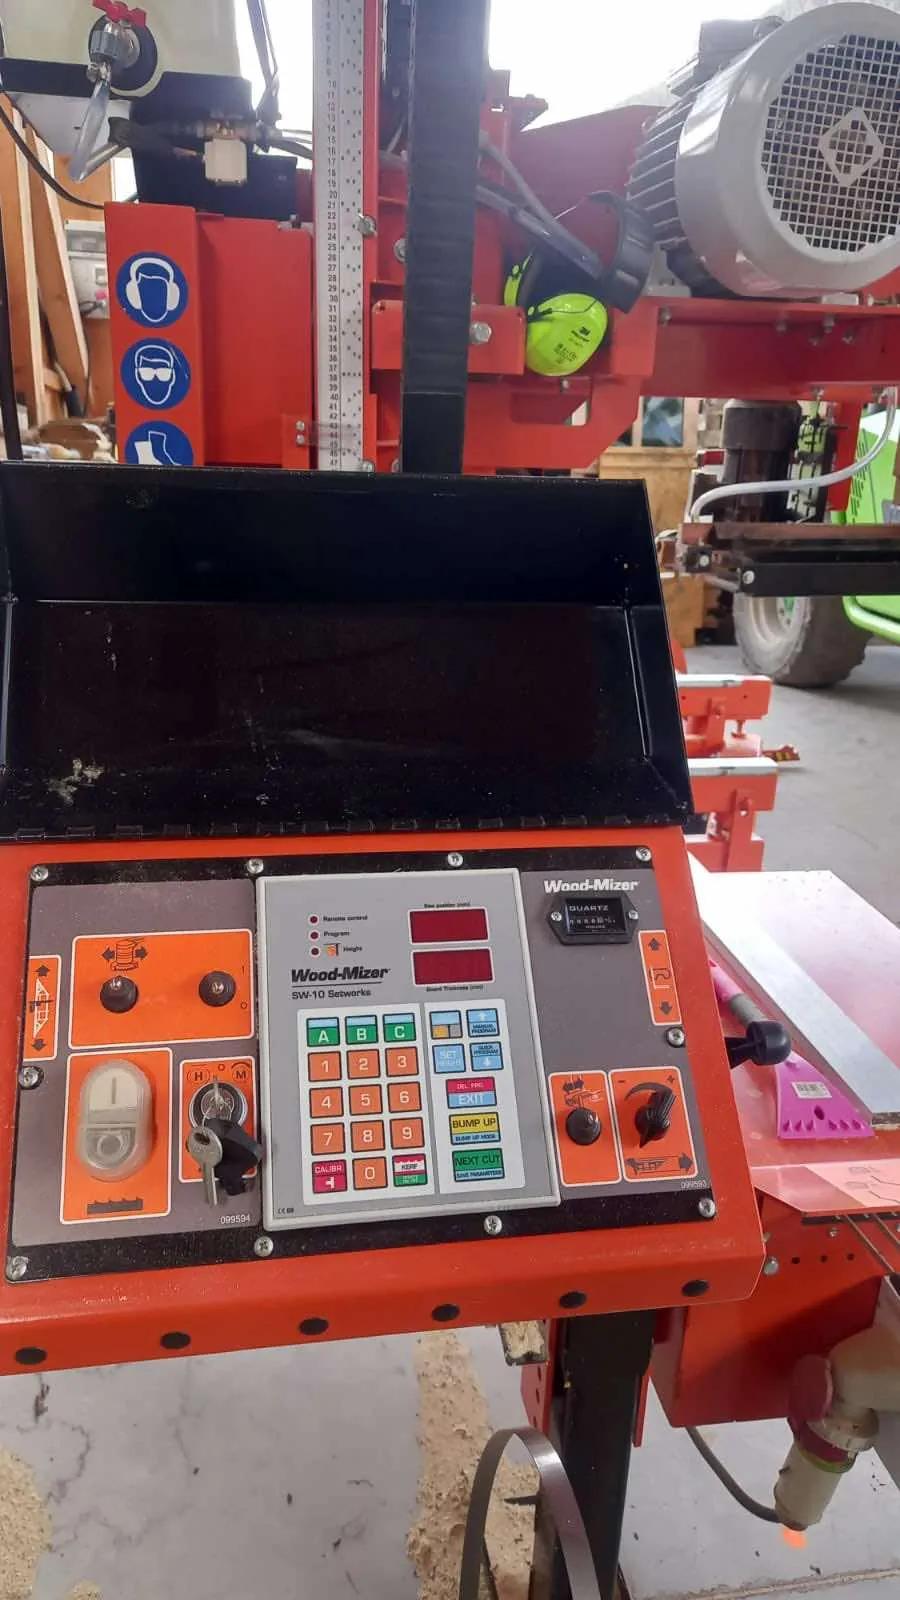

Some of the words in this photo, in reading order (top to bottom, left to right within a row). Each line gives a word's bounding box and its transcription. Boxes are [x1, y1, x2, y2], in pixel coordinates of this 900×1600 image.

[328, 158, 336, 167] 17
[328, 169, 336, 177] 18
[328, 180, 336, 188] 19
[330, 190, 337, 199] 20
[328, 201, 336, 209] 21
[328, 212, 336, 220] 22
[328, 222, 336, 230] 23
[328, 232, 336, 240] 24
[328, 254, 336, 262] 26
[328, 264, 336, 272] 27
[328, 274, 336, 282] 28
[328, 284, 336, 292] 29
[329, 304, 337, 312] 31
[329, 314, 337, 322] 32
[329, 354, 337, 362] 36
[329, 364, 337, 372] 37
[329, 374, 337, 382] 38
[329, 384, 337, 392] 39
[330, 394, 338, 402] 40
[329, 402, 337, 410] 41
[329, 412, 337, 420] 42
[329, 458, 337, 466] 47
[544, 879, 638, 893] Wood-Mizer
[324, 931, 350, 939] Program
[343, 946, 362, 954] Height
[291, 966, 389, 983] Wood-Mizer
[292, 990, 325, 1000] SW-10
[328, 988, 371, 998] Setworks
[356, 1028, 367, 1040] B
[394, 1026, 406, 1038] C
[318, 1030, 330, 1043] A
[440, 1050, 456, 1059] SET
[321, 1060, 329, 1072] 1
[359, 1058, 368, 1070] 2
[398, 1056, 407, 1068] 3
[194, 1072, 203, 1080] H
[236, 1070, 246, 1078] M
[361, 1094, 370, 1106] 5
[400, 1091, 409, 1104] 6
[458, 1094, 484, 1104] EXIT
[321, 1096, 332, 1108] 4
[452, 1119, 480, 1128] BUMP
[482, 1118, 496, 1126] UP
[362, 1129, 373, 1142] 8
[402, 1127, 412, 1140] 9
[323, 1132, 332, 1146] 7
[456, 1156, 479, 1166] NEXT
[482, 1152, 500, 1164] CUT
[314, 1165, 342, 1174] CALIBR
[401, 1162, 418, 1170] KERF
[364, 1166, 375, 1179] 0
[220, 1214, 250, 1224] 099594
